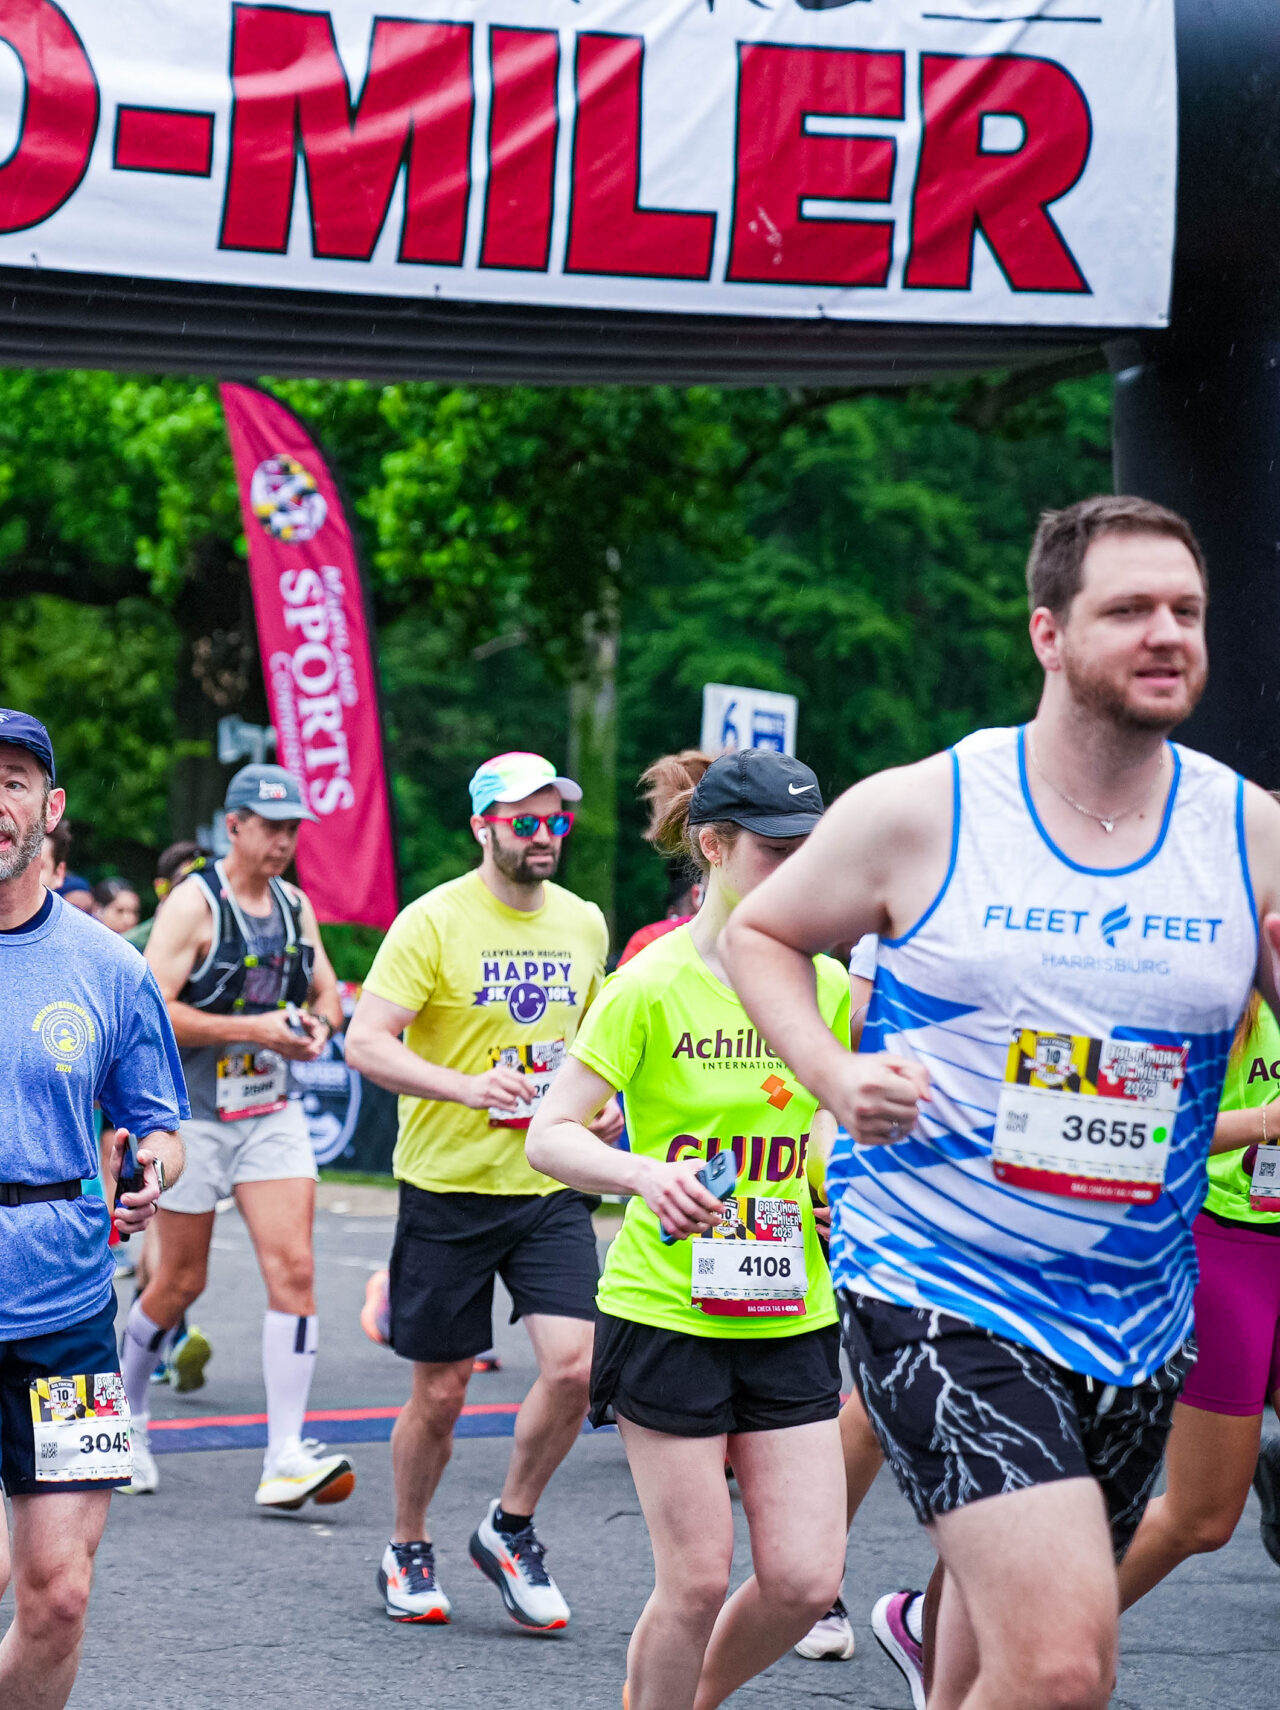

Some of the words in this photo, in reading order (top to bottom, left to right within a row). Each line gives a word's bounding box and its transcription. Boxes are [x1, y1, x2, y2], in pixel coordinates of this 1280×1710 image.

[280, 568, 355, 815] SPORTS
[984, 905, 1090, 935] FLEET
[1141, 914, 1224, 943] FEET
[483, 961, 572, 982] HAPPY
[1041, 953, 1172, 975] HARRISBURG
[1062, 1115, 1147, 1149] 3655
[758, 1200, 801, 1213] BALTIMORE
[772, 1226, 793, 1238] 2025
[738, 1256, 791, 1277] 4108
[57, 1389, 68, 1401] 10
[80, 1431, 128, 1454] 3045
